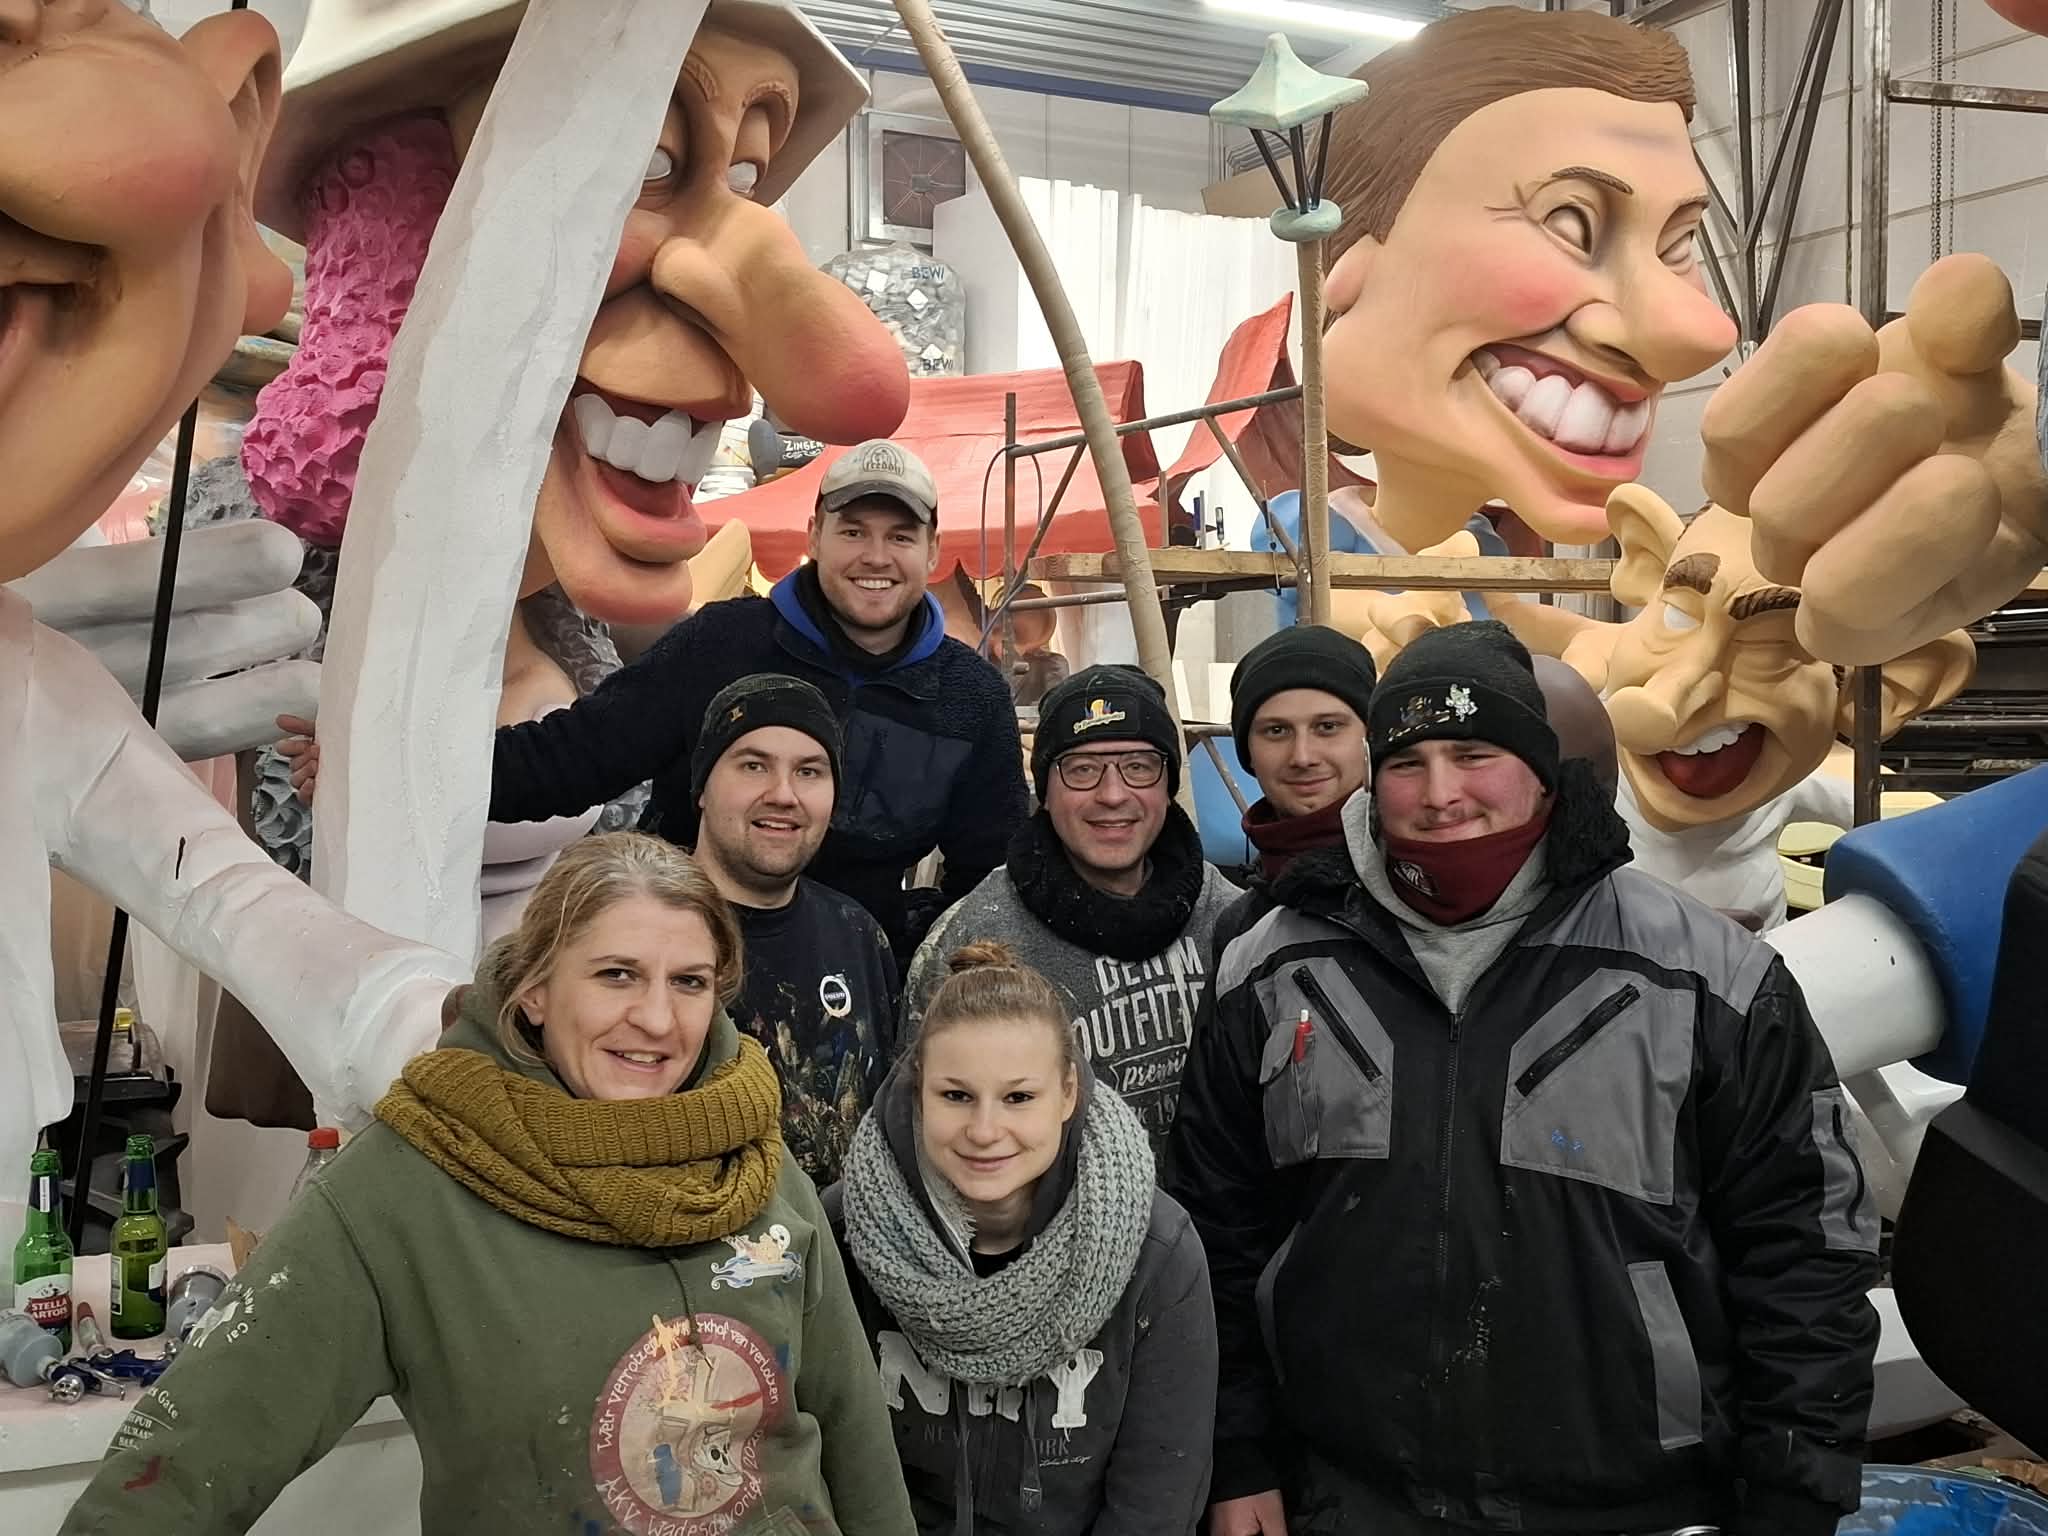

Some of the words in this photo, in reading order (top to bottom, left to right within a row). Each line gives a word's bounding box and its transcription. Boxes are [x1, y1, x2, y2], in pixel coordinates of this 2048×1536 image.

[912, 265, 945, 280] BEWI
[31, 1298, 68, 1312] STELLA
[158, 1390, 179, 1419] Gate
